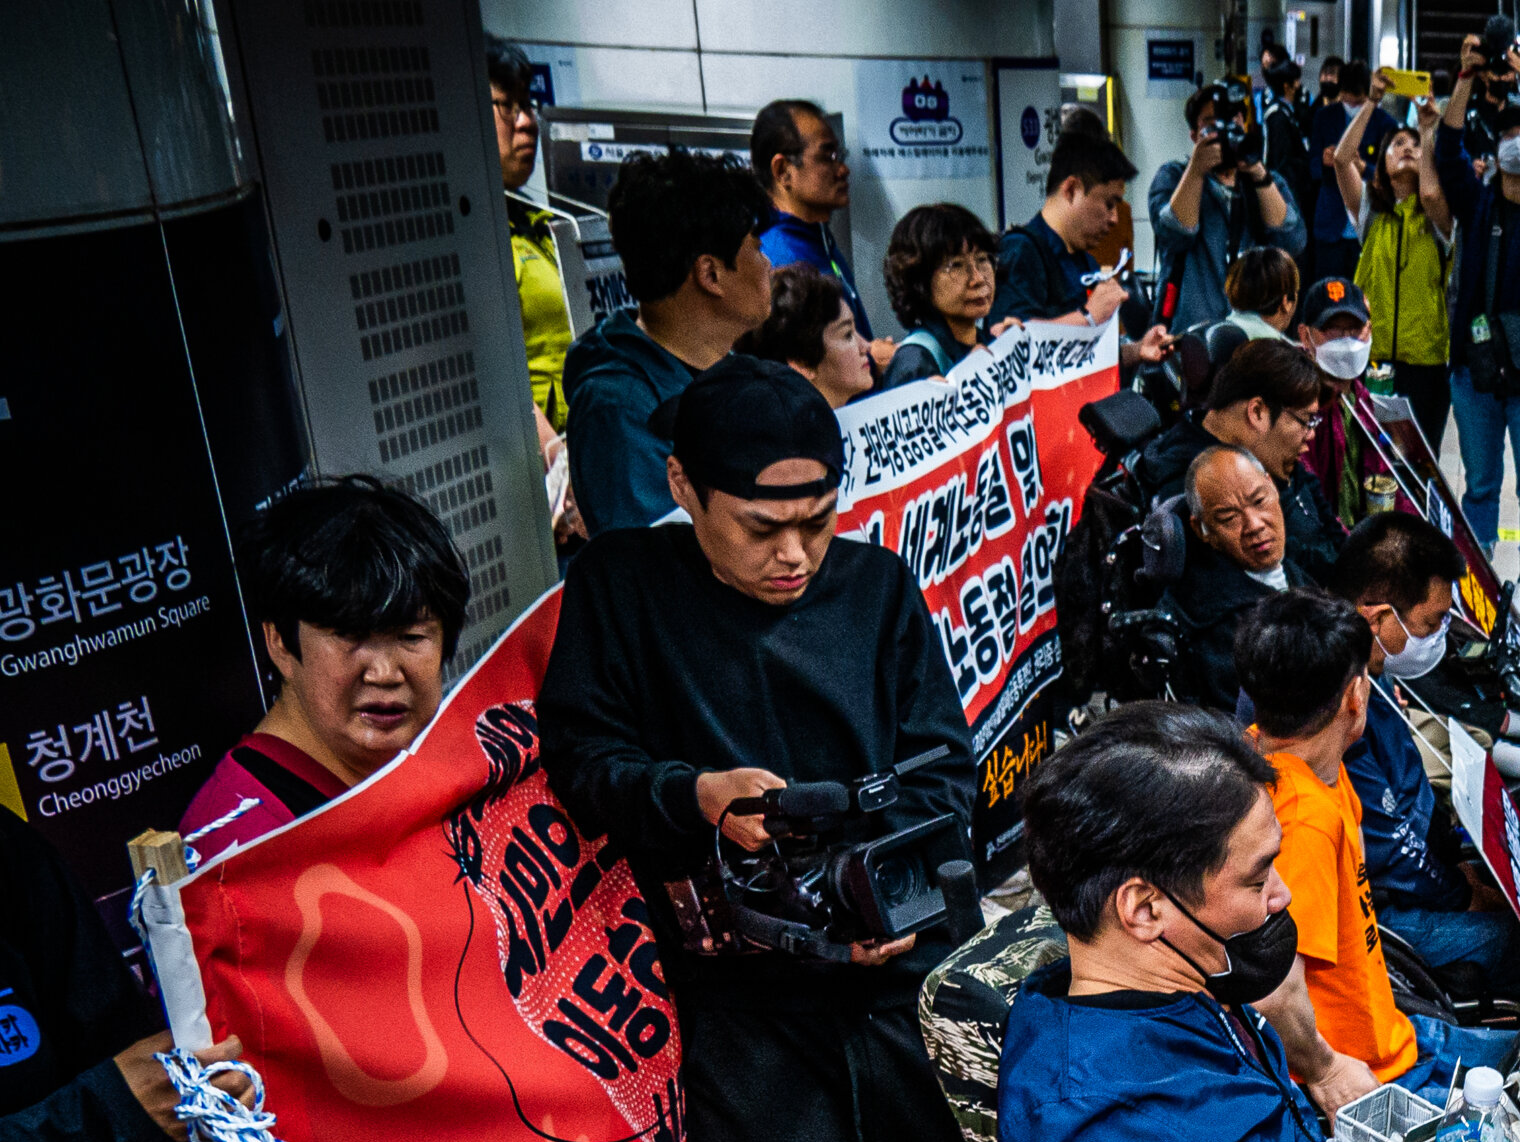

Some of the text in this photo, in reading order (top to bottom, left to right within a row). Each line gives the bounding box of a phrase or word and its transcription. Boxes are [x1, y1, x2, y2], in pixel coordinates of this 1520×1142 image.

[0, 535, 191, 642] 광화문광장
[1, 595, 211, 677] Gwanghwamun Square
[27, 696, 159, 783] 청계천
[38, 744, 201, 817] Cheonggyecheon
